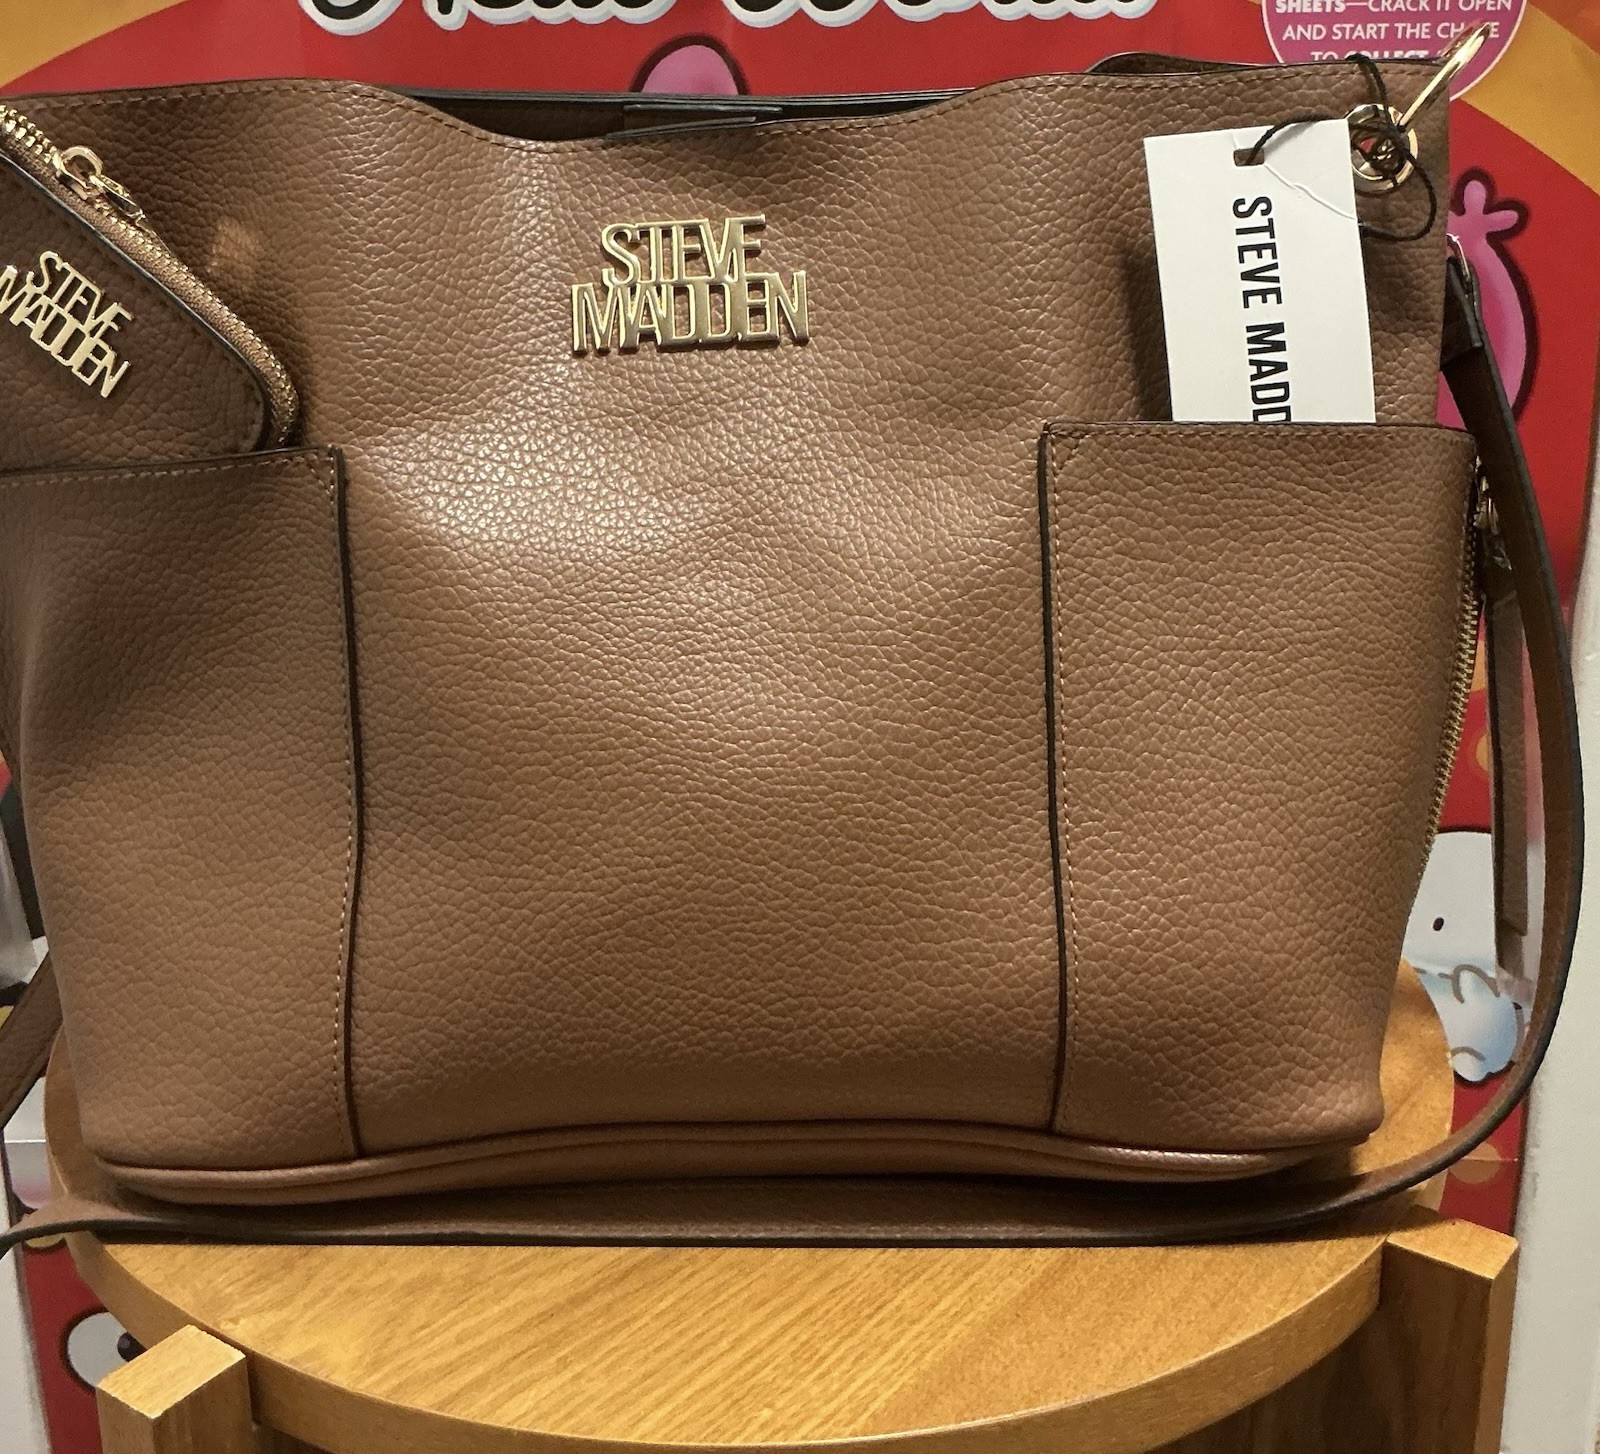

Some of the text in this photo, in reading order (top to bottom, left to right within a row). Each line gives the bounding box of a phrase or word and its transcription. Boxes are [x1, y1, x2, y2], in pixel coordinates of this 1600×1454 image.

[1282, 20, 1500, 41] AND START THE CHE
[1458, 0, 1512, 11] OPEN
[601, 213, 766, 287] STEVE
[1232, 196, 1283, 309] STEVE
[0, 265, 131, 398] MADDEN
[26, 250, 135, 339] STEVE
[571, 270, 810, 352] MADDEN
